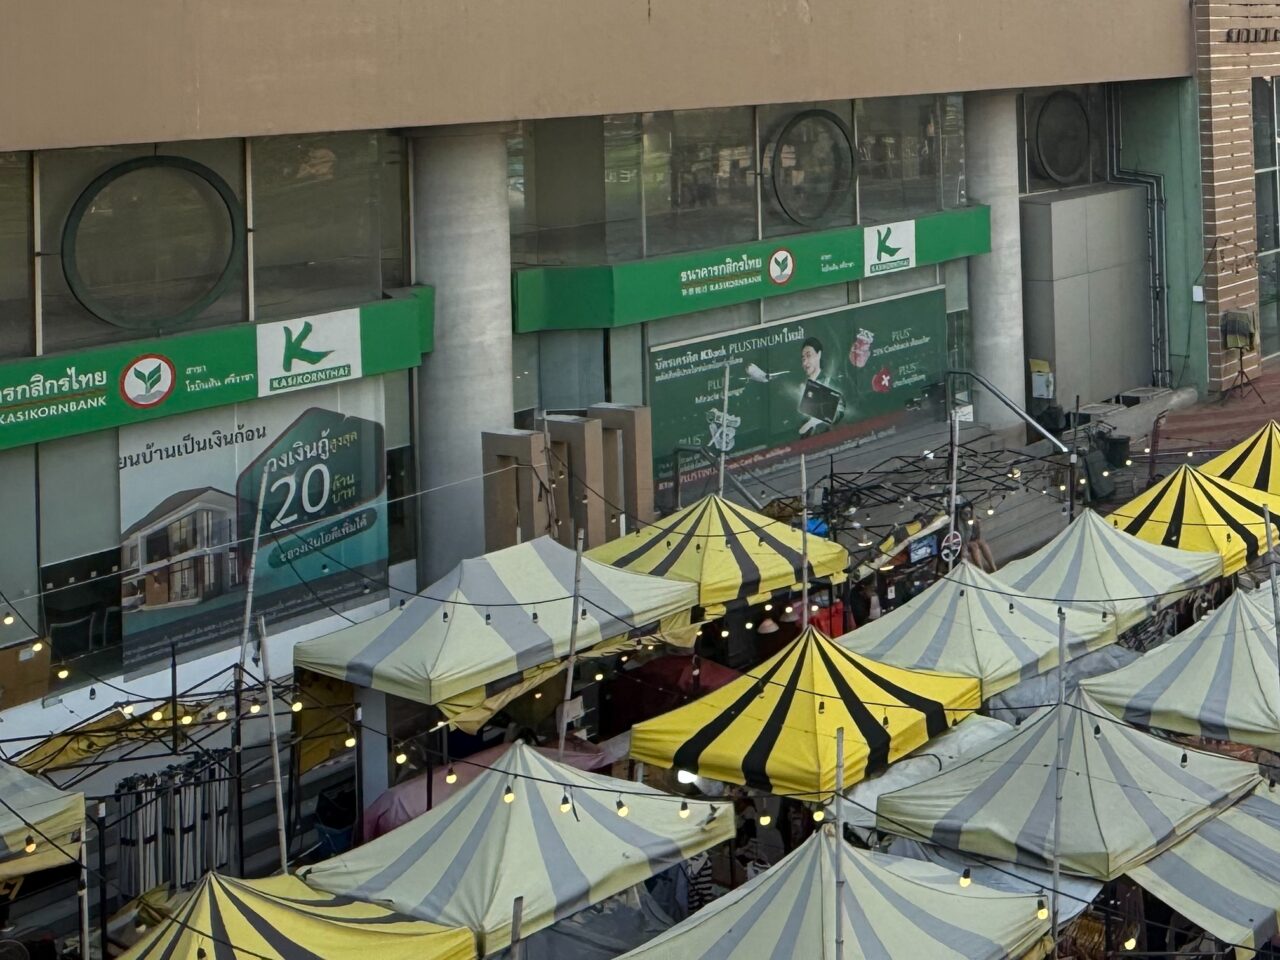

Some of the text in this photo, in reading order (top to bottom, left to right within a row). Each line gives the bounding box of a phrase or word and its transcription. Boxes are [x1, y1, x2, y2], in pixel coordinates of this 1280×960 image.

[680, 254, 762, 282] ธนาคารกสิกรไทย
[729, 333, 782, 355] PLUSTINUM
[272, 366, 350, 388] KASIKORNTHAI
[270, 463, 331, 530] 20
